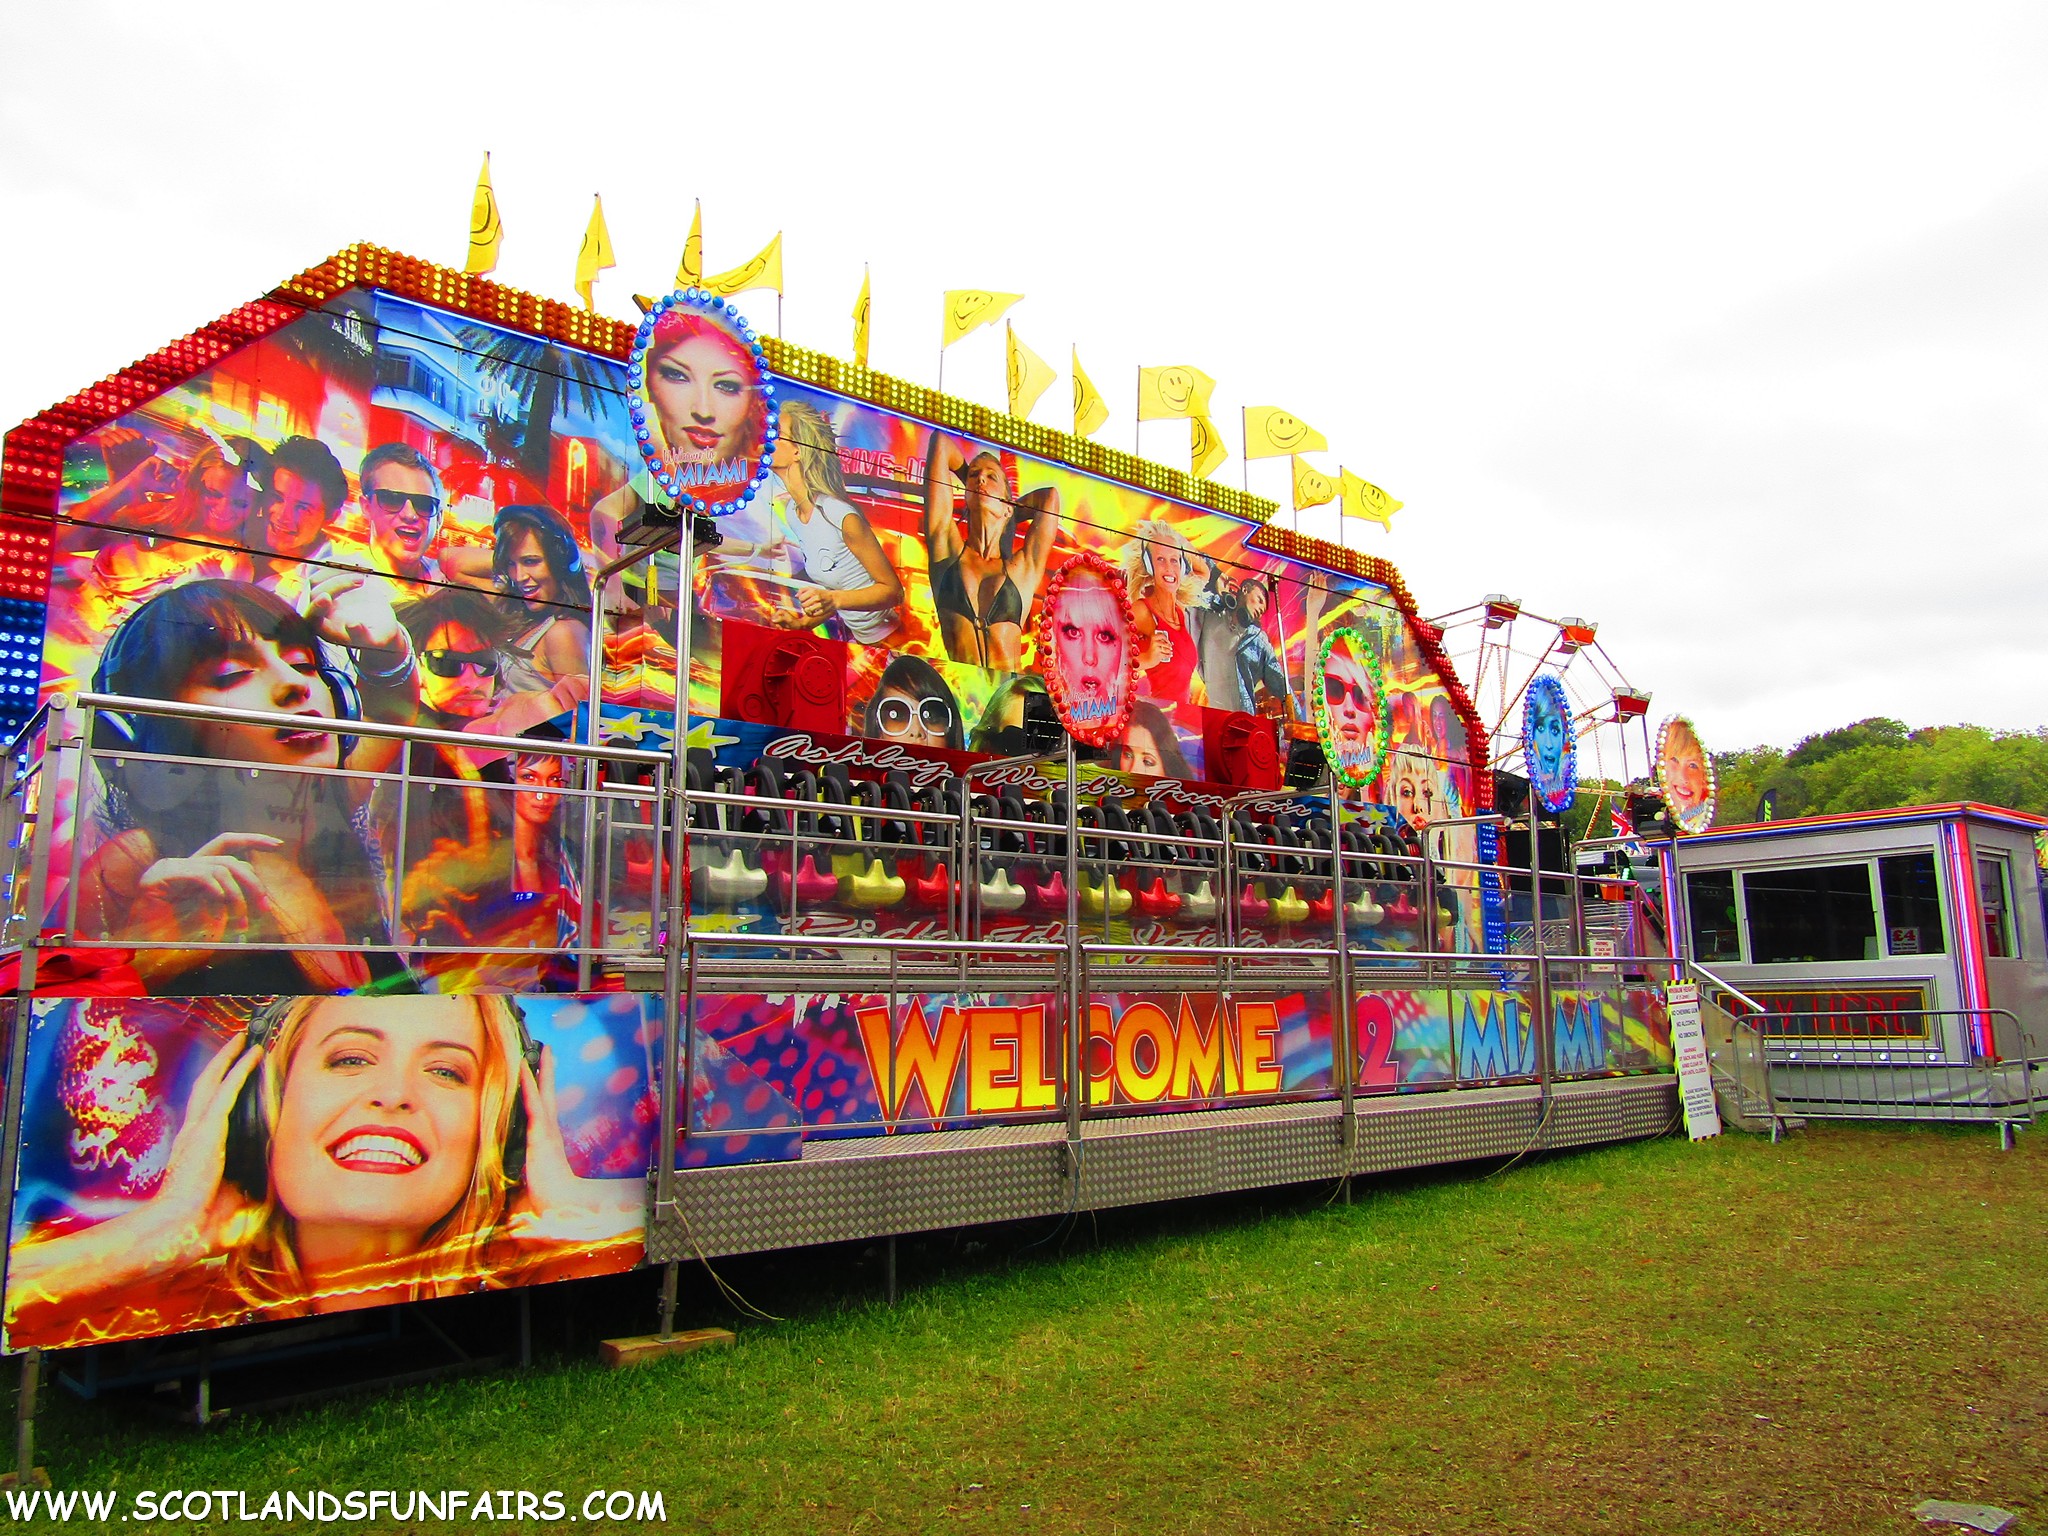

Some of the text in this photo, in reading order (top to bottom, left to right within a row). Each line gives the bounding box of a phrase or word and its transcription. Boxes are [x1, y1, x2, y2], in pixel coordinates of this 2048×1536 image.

[672, 457, 748, 490] MIAMI
[836, 446, 927, 485] RIVE-I
[1070, 696, 1116, 723] MIAMI
[763, 734, 954, 786] Ashley
[1337, 746, 1371, 769] MIAMI
[1893, 929, 1916, 942] £4
[1730, 996, 1914, 1033] PAY HERE
[855, 994, 1284, 1135] WELCOME
[1355, 992, 1399, 1093] 2
